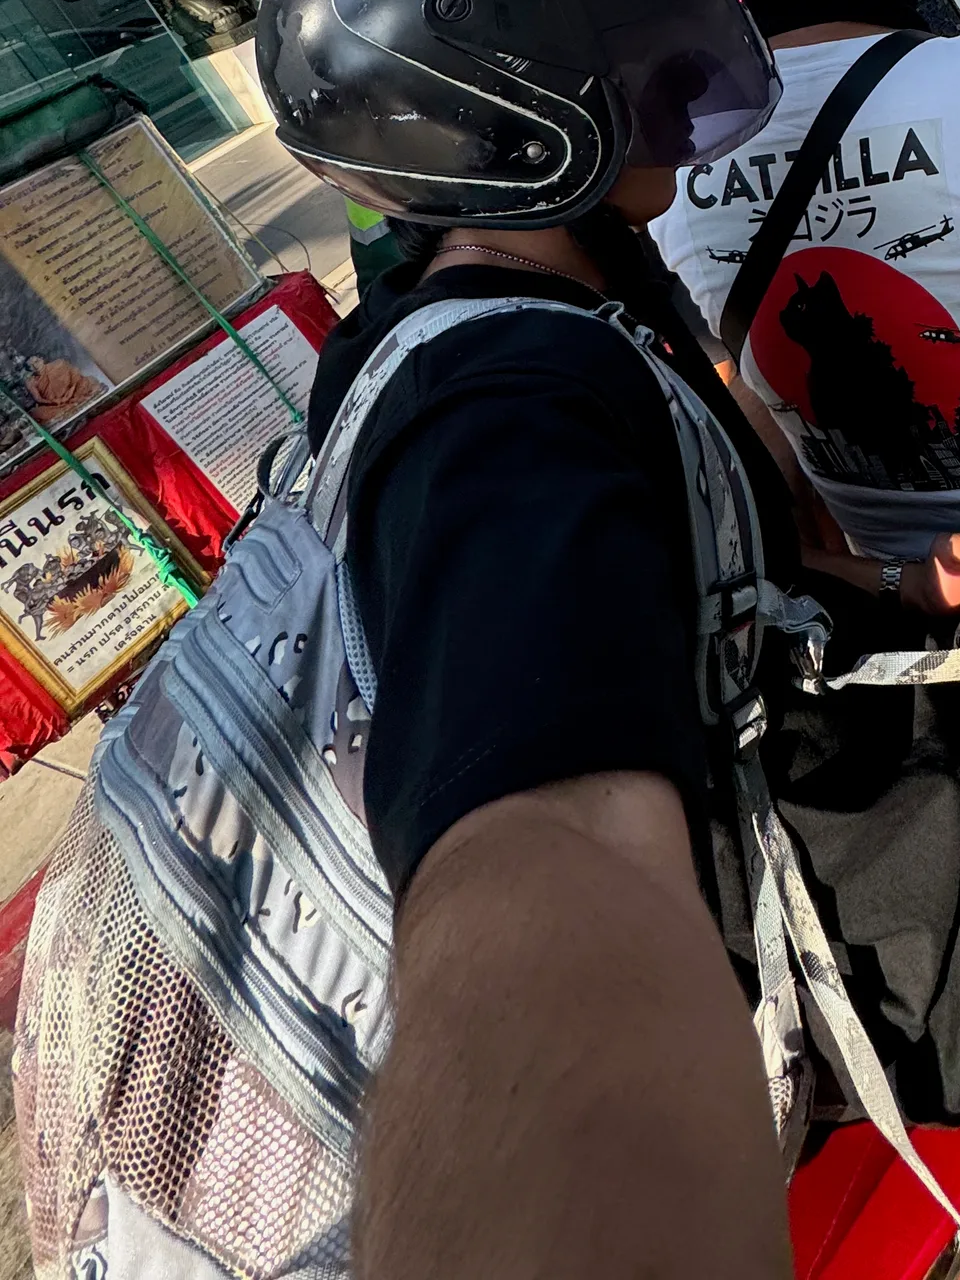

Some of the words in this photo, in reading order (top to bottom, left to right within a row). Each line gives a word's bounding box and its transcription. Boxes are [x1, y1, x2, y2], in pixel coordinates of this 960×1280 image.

[686, 127, 940, 211] CATILLA
[0, 475, 111, 567] นีนรก
[75, 644, 99, 666] นรก
[98, 622, 124, 647] เปรต
